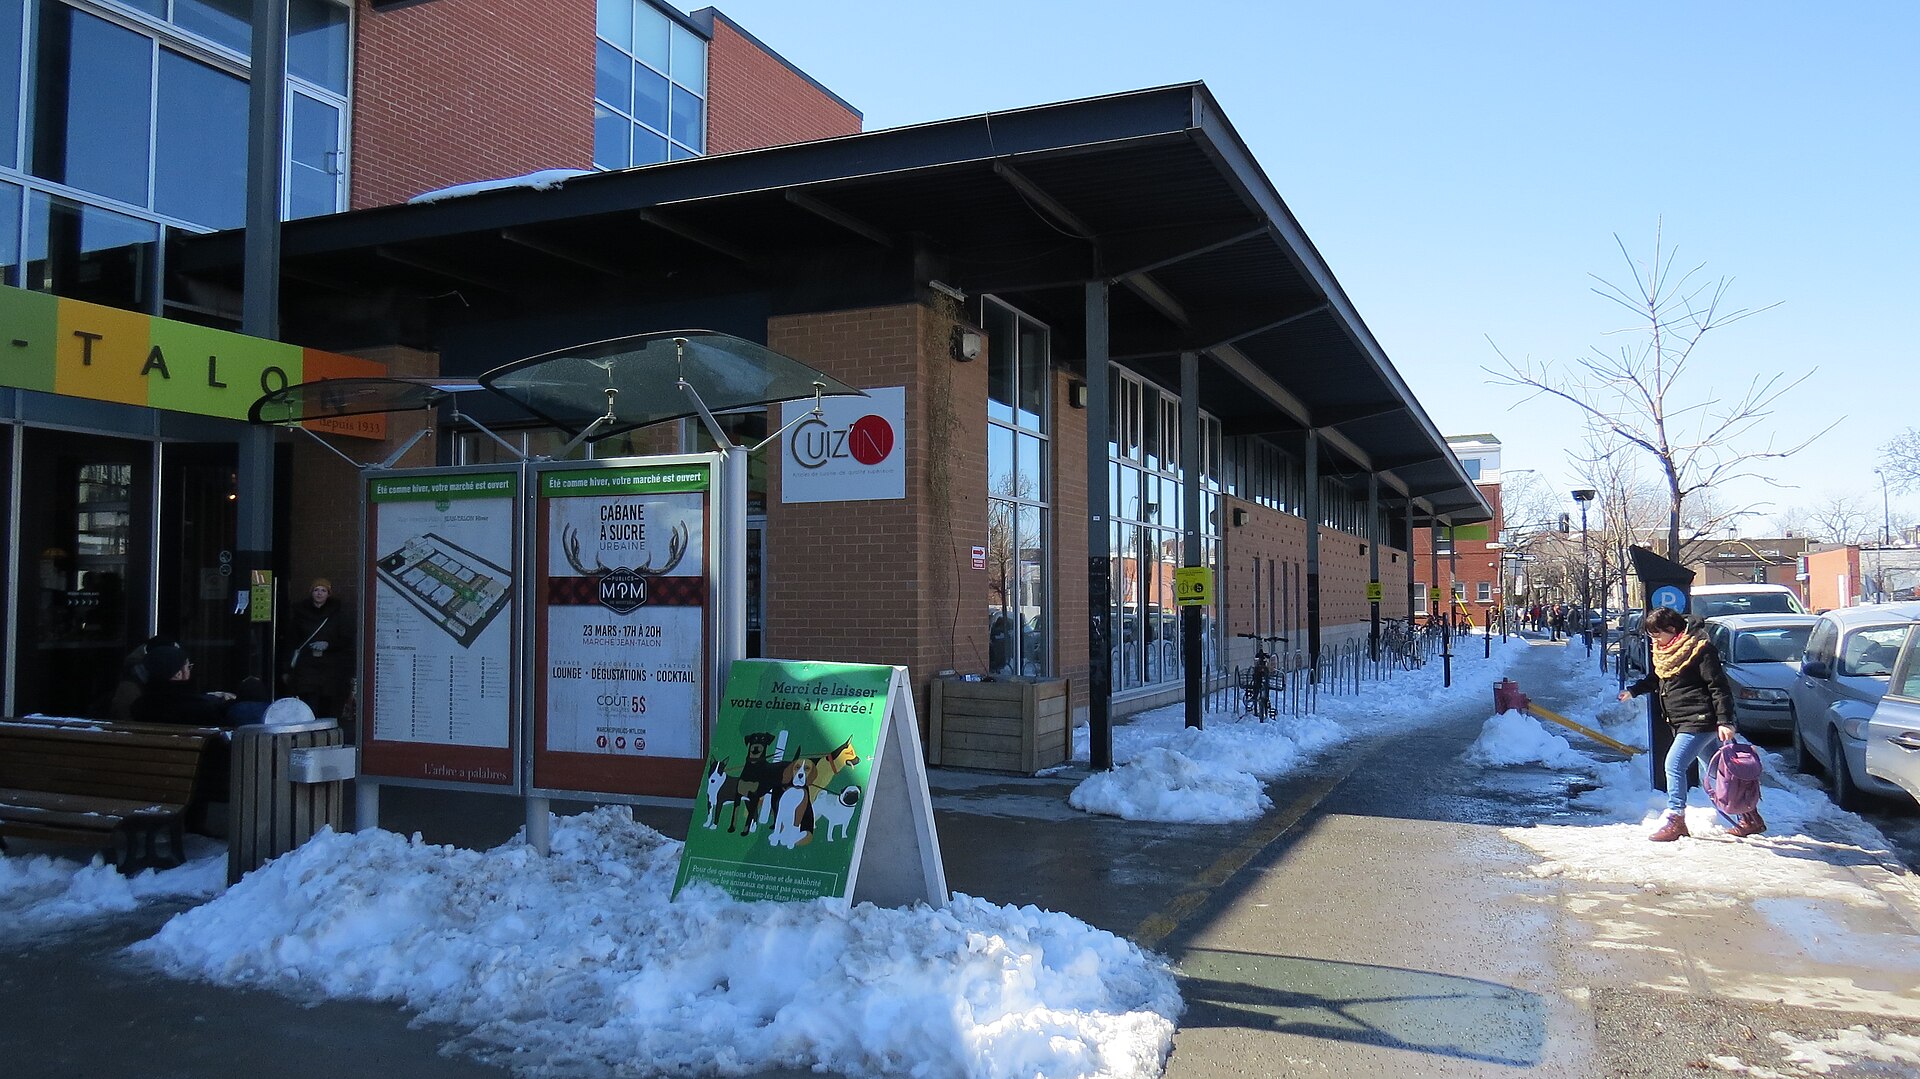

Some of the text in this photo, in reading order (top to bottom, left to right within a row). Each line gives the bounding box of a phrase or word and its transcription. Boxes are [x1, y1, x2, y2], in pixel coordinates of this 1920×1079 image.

[358, 421, 380, 433] 1933
[377, 484, 388, 494] Été
[412, 484, 430, 493] hiver,
[432, 484, 448, 492] votre
[450, 481, 474, 491] marché
[488, 480, 509, 489] ouvert
[549, 472, 701, 488] Été comme hiver, votre marché est ouvert
[600, 504, 644, 521] CABANE
[600, 522, 645, 540] À SUCRE
[600, 542, 645, 551] URBAINE
[602, 582, 644, 599] MPM
[583, 624, 661, 637] 23 MARS 17H À 20H
[583, 637, 661, 647] MARCHÉ JEAN-TALON
[553, 667, 695, 682] LOUNGE DÉGUSTATIONS COCKTAIL
[771, 682, 878, 698] Merci de laisser
[632, 696, 646, 714] 5$
[730, 699, 763, 709] votre
[765, 697, 801, 711] chien
[804, 699, 811, 711] à
[424, 763, 457, 776] L'arbre
[467, 767, 507, 780] palabres
[693, 864, 706, 873] Pour
[707, 866, 717, 874] des
[718, 868, 746, 878] questions
[747, 870, 777, 881] d'hygiène
[785, 875, 793, 883] de
[794, 876, 821, 887] salubrité
[720, 876, 729, 885] les
[730, 879, 755, 888] animaux
[792, 888, 819, 896] acceptés
[742, 889, 774, 900] Laissez-les
[774, 893, 790, 901] dans
